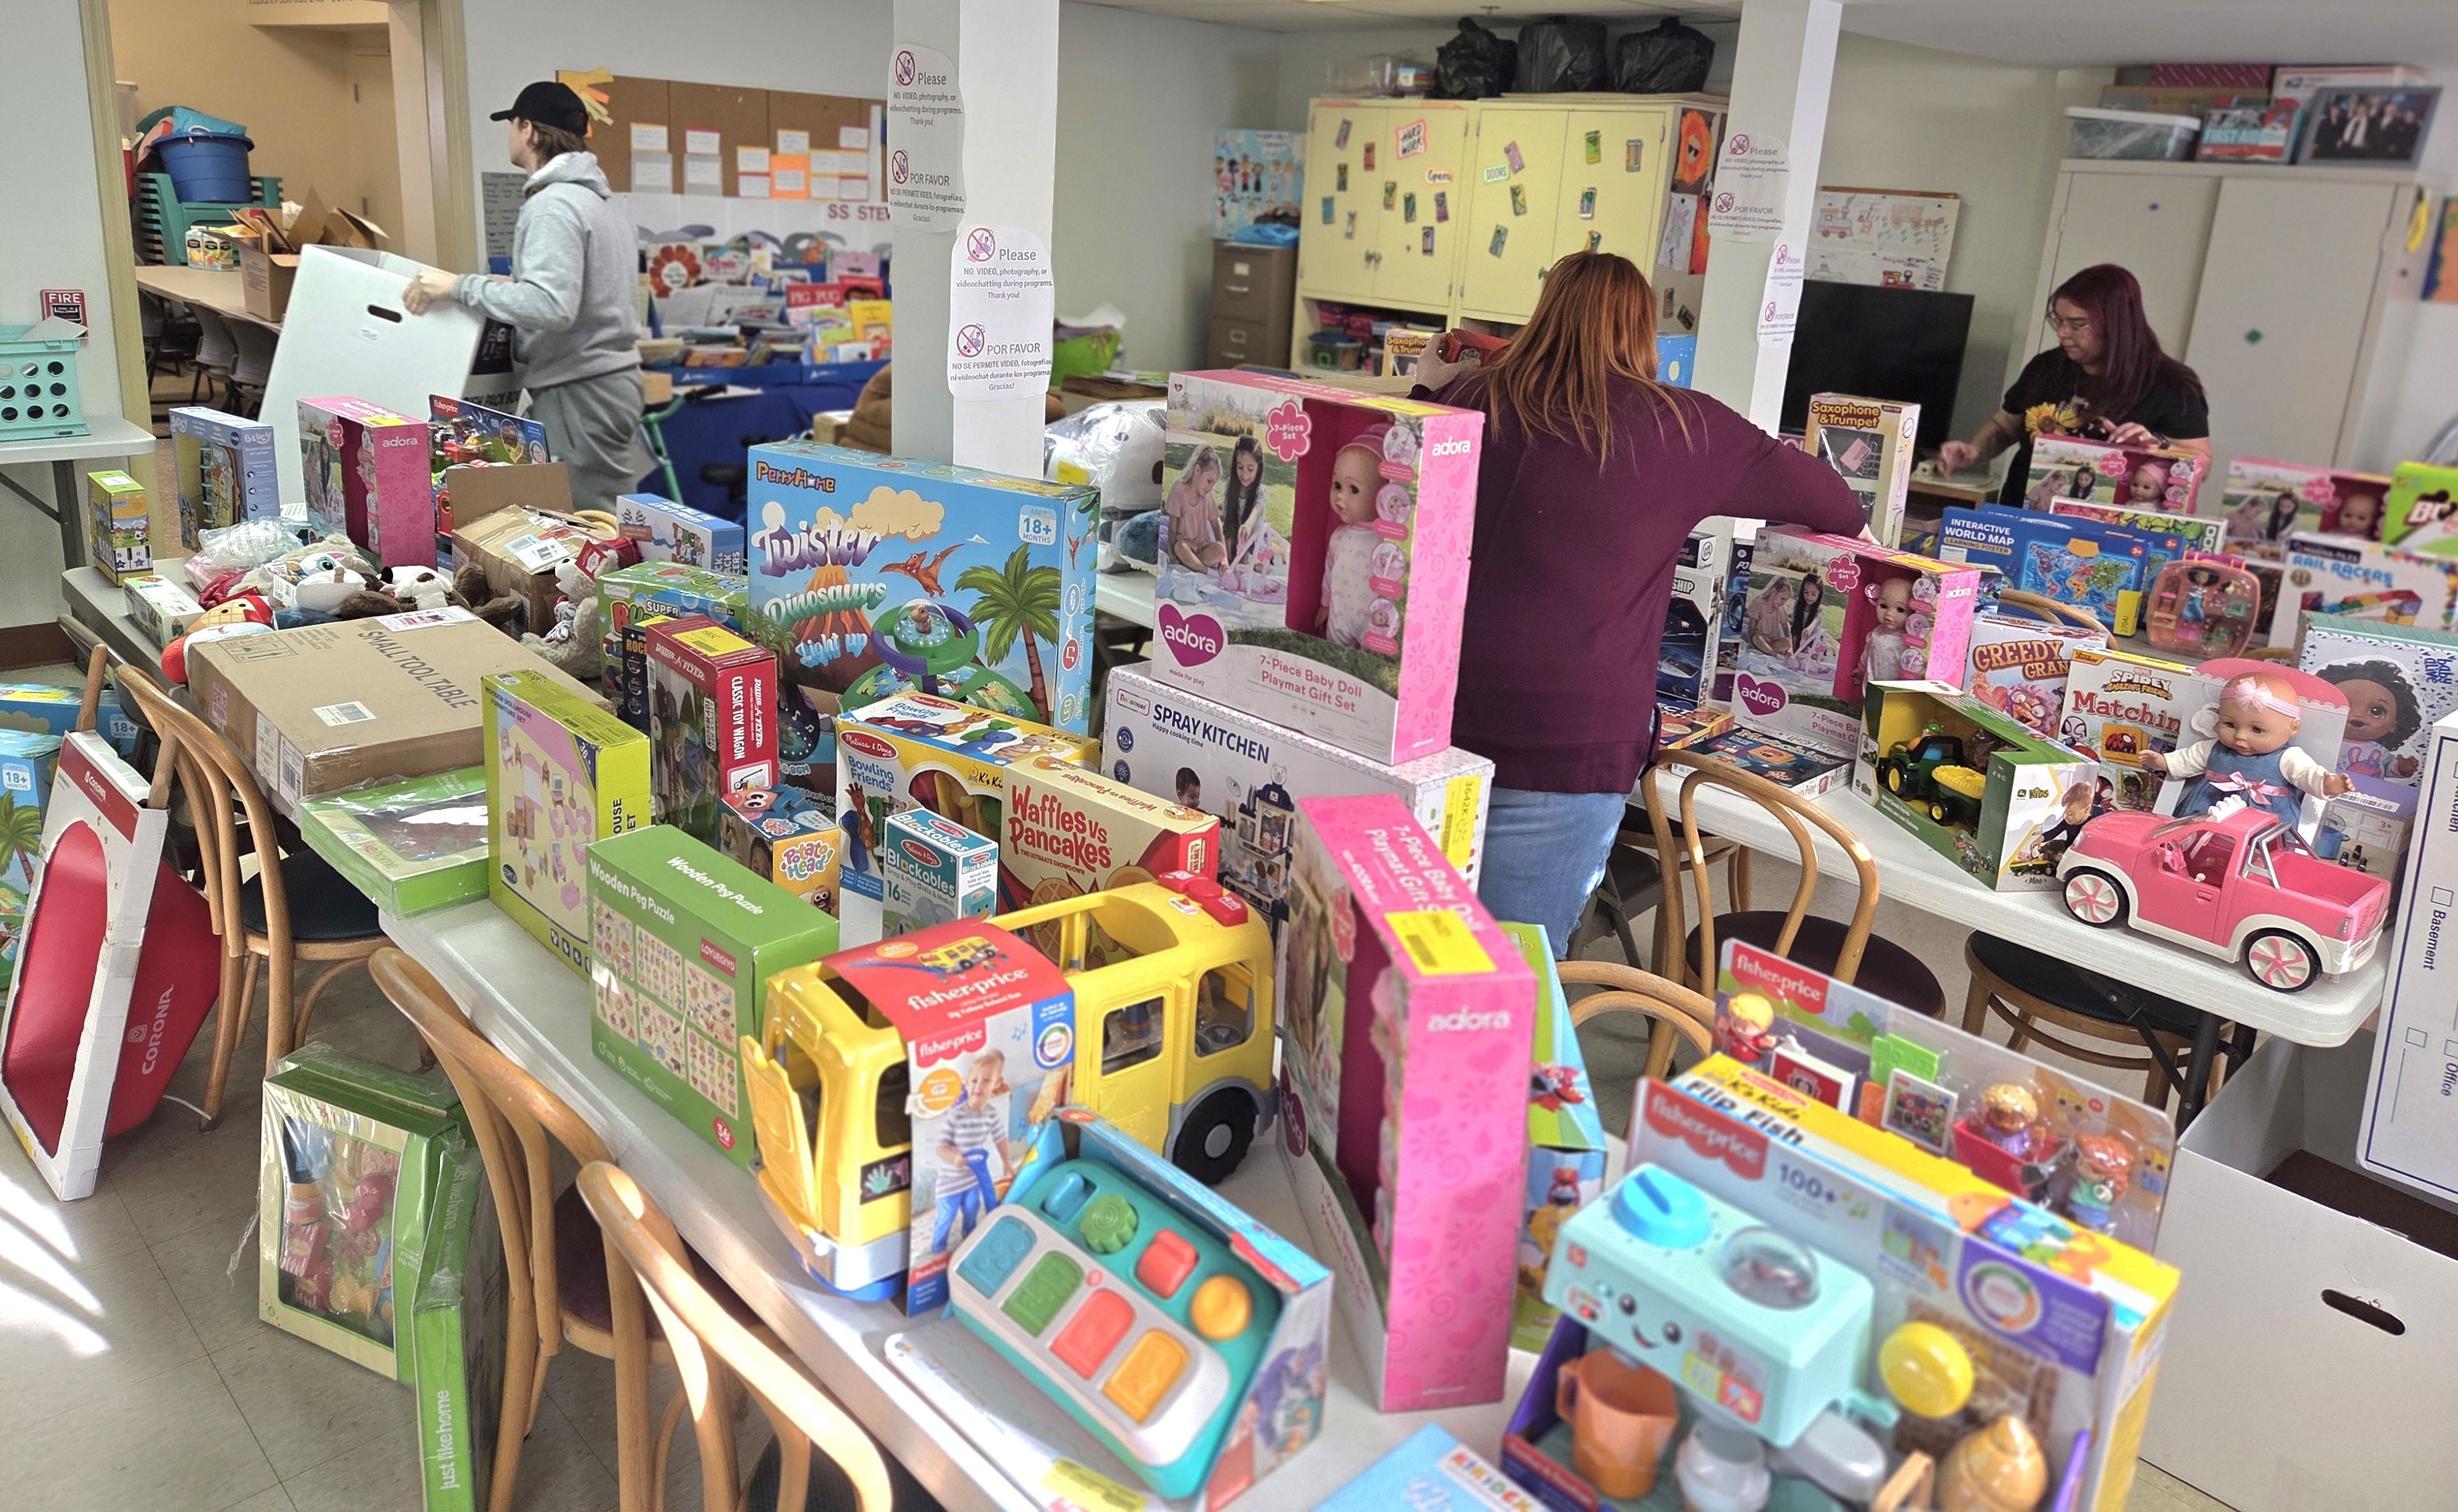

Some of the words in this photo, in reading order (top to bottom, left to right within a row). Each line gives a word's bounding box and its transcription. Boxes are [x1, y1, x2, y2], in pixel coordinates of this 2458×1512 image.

[918, 72, 947, 85] Please
[919, 93, 949, 101] photography,
[922, 105, 936, 114] during
[937, 107, 963, 116] programs.
[1402, 124, 1422, 142] HARD
[2203, 128, 2236, 143] FIRST
[2238, 130, 2260, 144] AID
[1402, 136, 1422, 154] WORK
[910, 173, 923, 184] POR
[925, 174, 950, 186] FAVOR
[1486, 166, 1507, 179] DOORS
[920, 191, 933, 200] VIDEO,
[828, 203, 849, 219] SS
[999, 249, 1037, 261] Please
[976, 268, 998, 277] VIDEO,
[1000, 268, 1040, 277] photography,
[956, 280, 1002, 289] videochatting
[1003, 279, 1023, 288] during
[1024, 280, 1053, 289] programs.
[49, 293, 81, 303] FIRE
[790, 289, 811, 304] PIG
[816, 289, 841, 303] PUG
[987, 344, 1007, 355] POR
[1010, 342, 1040, 353] FAVOR
[1000, 359, 1020, 368] VIDEO,
[958, 372, 989, 381] videochat
[990, 371, 1013, 380] durante
[989, 383, 1015, 392] Gracias!
[1812, 402, 1880, 417] Saxophone
[1819, 414, 1879, 427] &Trumpet
[382, 436, 419, 447] adora
[1282, 431, 1296, 440] Set
[1432, 436, 1471, 456] adora
[1023, 516, 1052, 535] 18+
[1945, 526, 1986, 542] WORLD
[1988, 532, 2015, 547] MAP
[1951, 518, 2012, 536] INTERACTIVE
[751, 518, 883, 578] Twister
[1022, 534, 1051, 545] MONTHS
[1945, 538, 1979, 550] LEARNING
[1980, 542, 2010, 554] POSTER
[675, 539, 702, 567] TRACK
[2293, 554, 2327, 573] RAIL
[2330, 561, 2393, 588] RACERS
[762, 580, 887, 625] Dinosaurs
[1945, 585, 1972, 599] adora
[795, 632, 840, 668] Light
[845, 631, 868, 659] up
[1164, 623, 1217, 655] adora
[1974, 640, 2065, 672] GREEDY
[358, 631, 409, 659] SMALL
[393, 655, 440, 682] TOOL
[423, 679, 478, 709] TABLE
[1260, 655, 1302, 677] 7-Piece
[1305, 669, 1334, 689] Baby
[1338, 680, 1362, 698] Doll
[2023, 660, 2071, 682] GRAN
[2111, 669, 2173, 691] SPIDEY
[2436, 658, 2454, 685] baby
[731, 675, 743, 709] CLASSIC
[1262, 671, 1306, 695] Playmat
[1309, 687, 1332, 704] Gift
[1335, 695, 1356, 712] Set
[1741, 684, 1780, 709] adora
[2106, 682, 2141, 693] AMAZING
[2142, 685, 2173, 699] FRIENDS
[732, 710, 744, 725] TOY
[885, 707, 931, 720] Friends
[894, 703, 941, 718] Bowling
[1063, 698, 1072, 722] LED
[2072, 690, 2182, 734] Matchin
[113, 722, 136, 733] 18+
[1152, 722, 1169, 736] Happy
[1169, 728, 1190, 744] cooking
[1191, 736, 1204, 748] time
[1153, 703, 1201, 735] SPRAY
[1202, 722, 1270, 764] KITCHEN
[1812, 722, 1846, 741] Playmat
[733, 725, 746, 760] WAGON
[845, 733, 871, 749] Melissa
[877, 744, 893, 757] Doug
[6, 771, 27, 784] 18+
[848, 755, 895, 784] Bowling
[851, 767, 892, 793] Friends
[1011, 784, 1087, 833] Waffles
[1088, 819, 1107, 844] vs
[2379, 821, 2392, 829] 3+
[895, 814, 969, 852] Blockables
[783, 841, 831, 866] Potato
[1008, 816, 1112, 873] Pancakes
[787, 859, 828, 881] Head
[887, 847, 956, 899] Blockables
[962, 858, 997, 873] Blockables
[1030, 851, 1053, 865] ULTIMATE
[1053, 859, 1085, 875] SHOWDOWN
[590, 857, 630, 899] Wooden
[630, 886, 647, 912] Peg
[647, 897, 675, 924] Puzzle
[667, 856, 714, 888] Wooden
[710, 883, 735, 899] Peg
[729, 893, 765, 916] Puzzle
[887, 880, 901, 902] 16
[2029, 876, 2042, 885] Moo
[2423, 908, 2446, 971] Basement
[701, 942, 735, 972] LOYUEGIYO
[1737, 953, 1822, 1002] fisher-price
[907, 969, 1029, 1010] fisher-price
[141, 985, 175, 1076] CORONA
[1427, 1006, 1512, 1034] adora
[919, 1029, 983, 1058] fisher-price
[2441, 1061, 2458, 1097] Office
[1685, 1078, 1737, 1111] Flip
[1744, 1109, 1804, 1145] Fish
[1651, 1093, 1760, 1164] fisher-price
[1779, 1164, 1837, 1203] 100+
